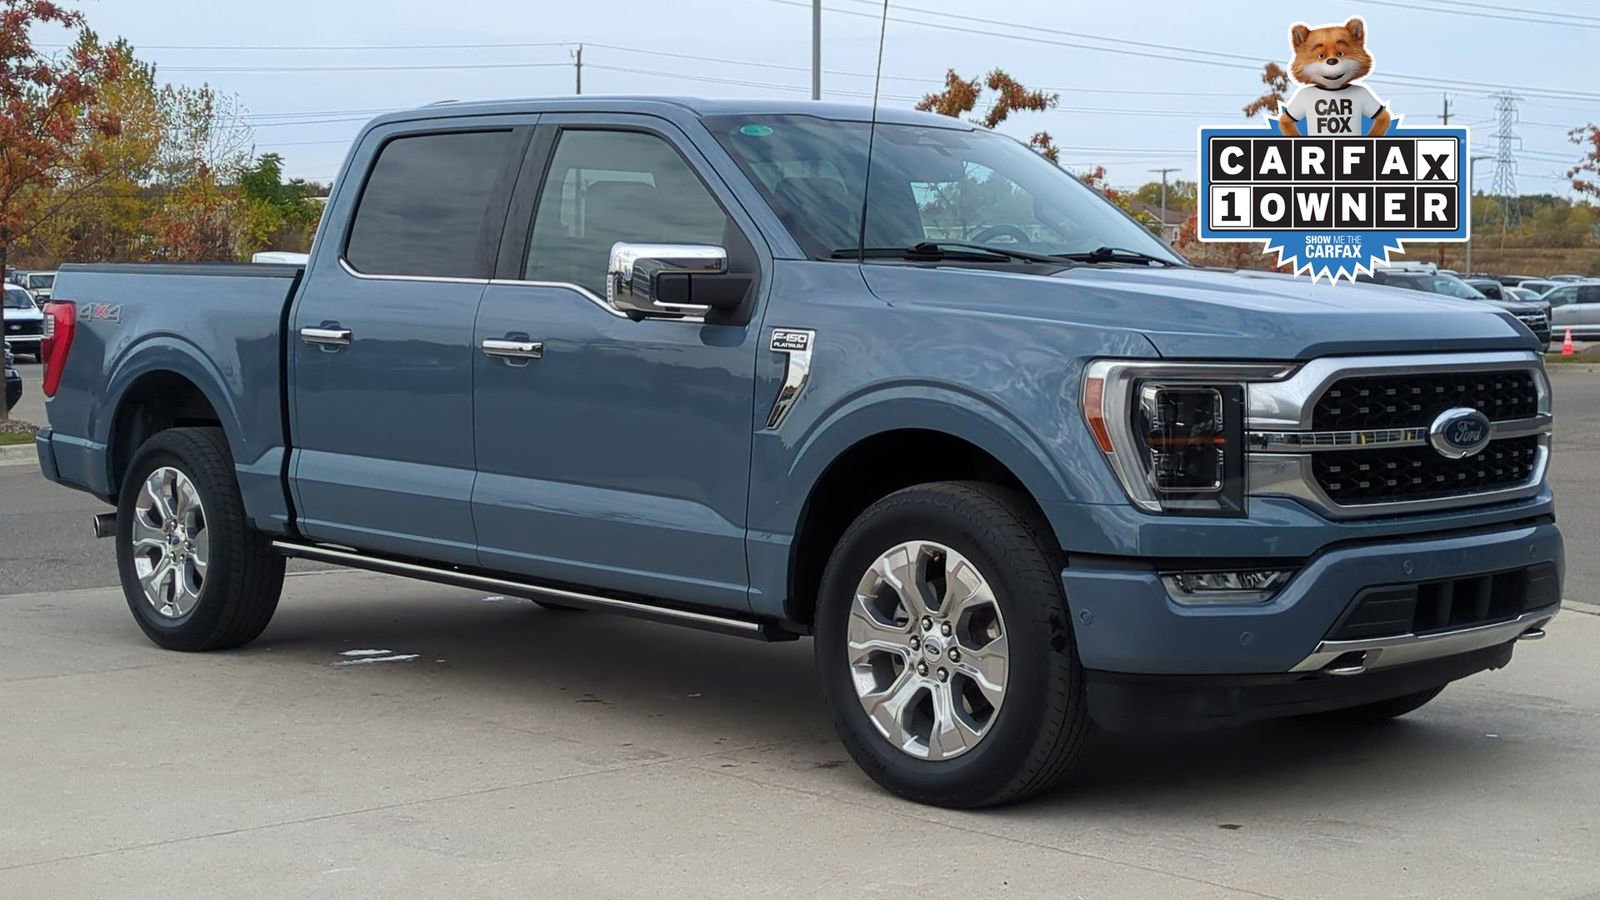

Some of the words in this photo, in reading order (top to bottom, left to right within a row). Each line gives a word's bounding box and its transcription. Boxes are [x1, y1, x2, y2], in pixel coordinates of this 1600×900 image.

[773, 332, 808, 343] F-150
[773, 341, 804, 349] PLATINUM
[1454, 420, 1482, 442] Ford
